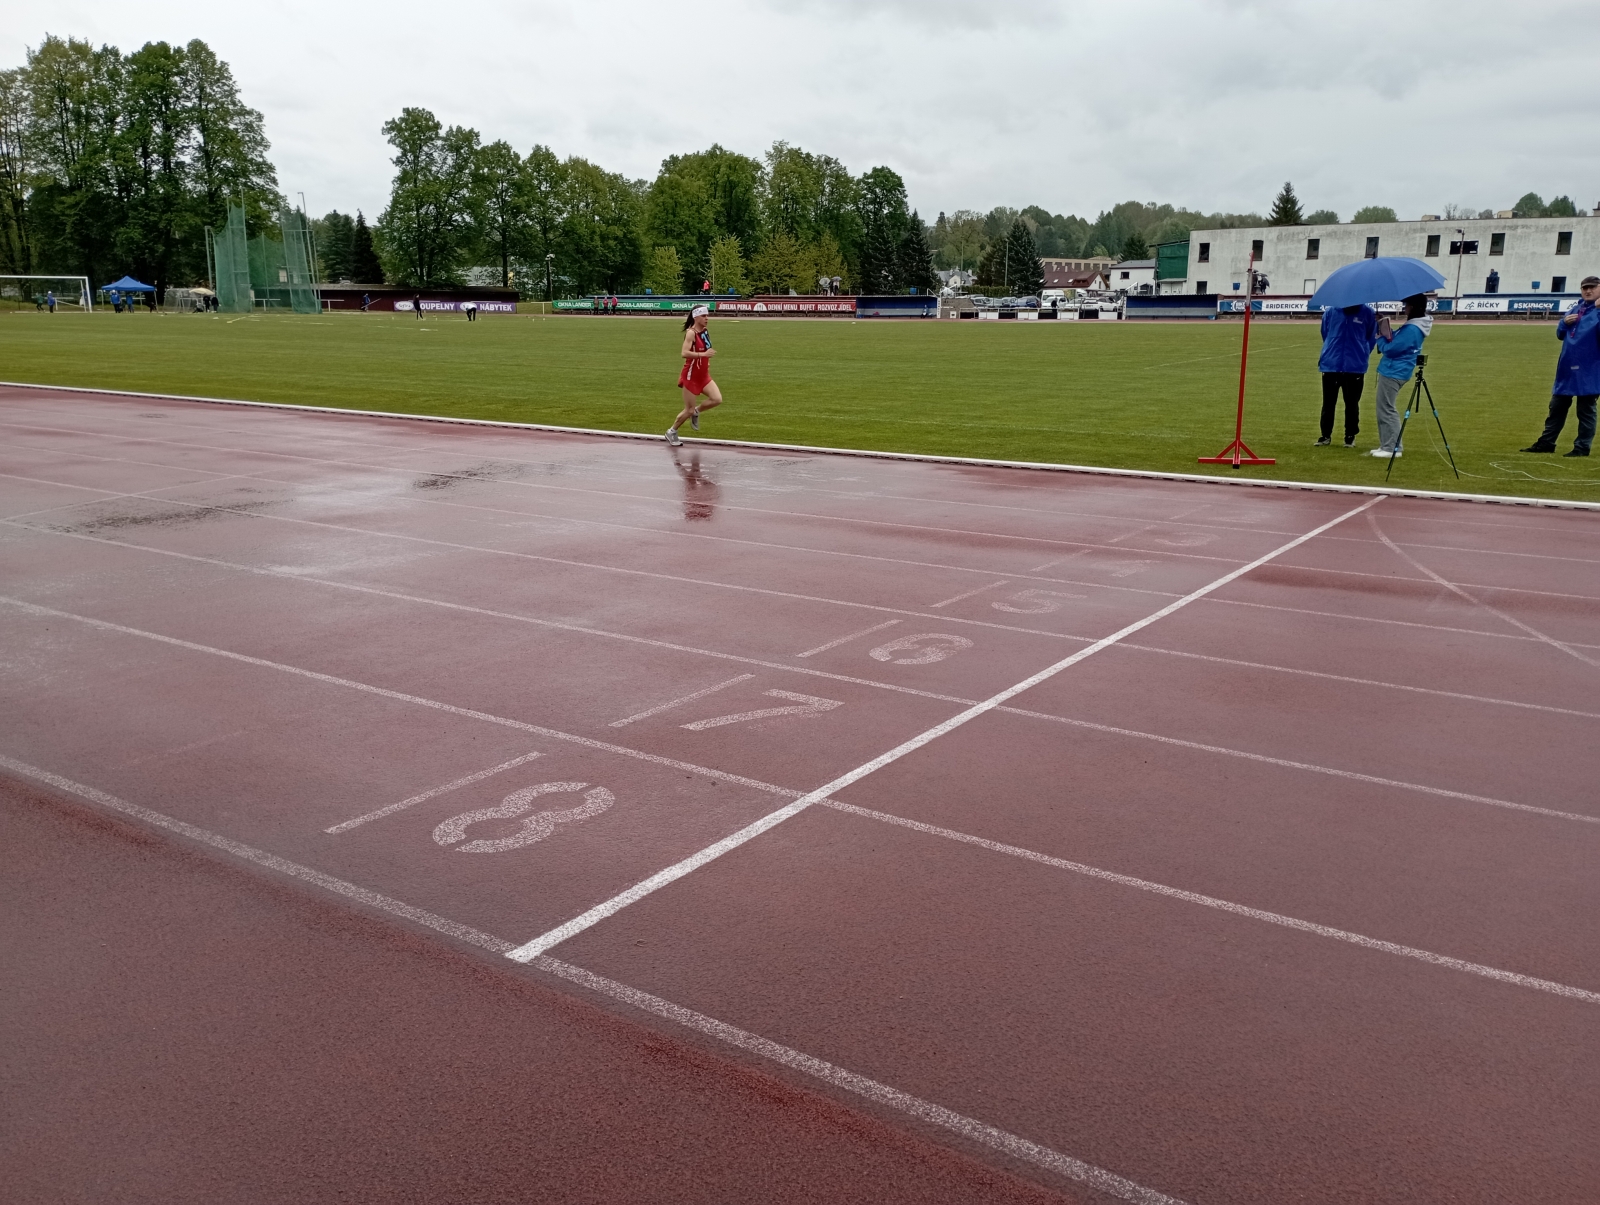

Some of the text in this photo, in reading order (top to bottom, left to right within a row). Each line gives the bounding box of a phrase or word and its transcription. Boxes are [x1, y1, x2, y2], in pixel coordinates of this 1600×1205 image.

[420, 302, 455, 310] OUPELNY
[479, 302, 512, 311] NÁBYTEK
[783, 303, 798, 311] MENU
[799, 303, 815, 311] BUFET
[817, 303, 837, 311] ROZVOZ
[838, 302, 853, 311] JÍDEL
[991, 588, 1088, 614] 5
[680, 688, 844, 731] 7
[432, 781, 615, 854] 8
